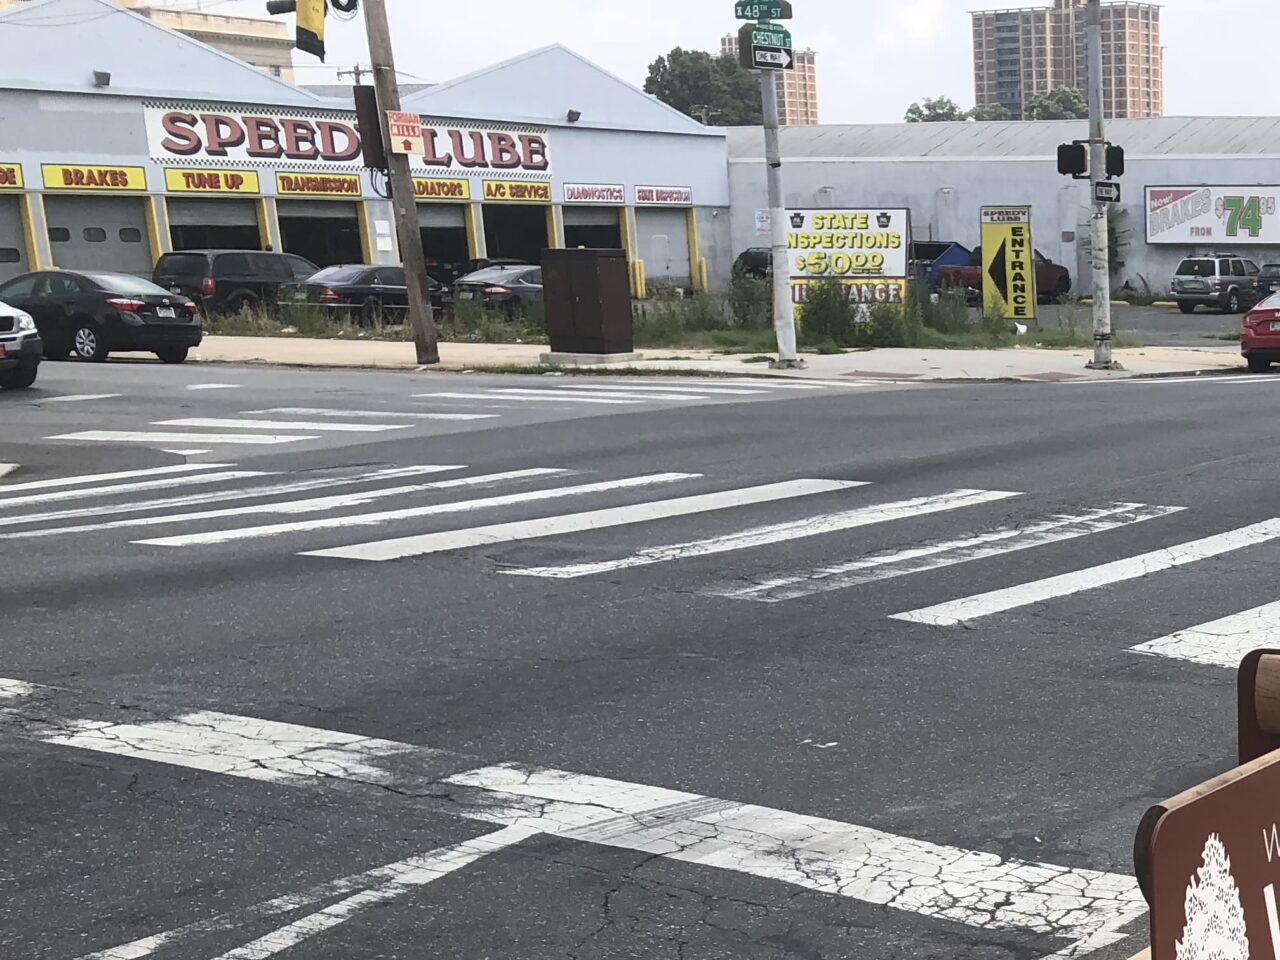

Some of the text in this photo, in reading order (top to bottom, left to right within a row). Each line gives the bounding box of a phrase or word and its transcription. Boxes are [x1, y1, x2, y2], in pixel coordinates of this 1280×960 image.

[771, 8, 781, 17] ST
[752, 30, 784, 46] CHESTNUT
[160, 111, 549, 171] SPEED LUBE
[62, 168, 129, 187] BRAKES
[182, 172, 243, 190] TUNE UP
[279, 176, 359, 193] TRANSMISSION
[411, 180, 463, 197] ADIATORS
[486, 184, 549, 199] A/C SERVICE
[567, 186, 623, 200] DIAGNOSTICS
[1151, 193, 1173, 209] Now!
[1150, 188, 1211, 237] BRAKES
[1190, 227, 1212, 236] FROM
[812, 213, 868, 230] STATE
[786, 232, 901, 249] NSPECTIONS
[1011, 227, 1026, 316] ENTRANCE
